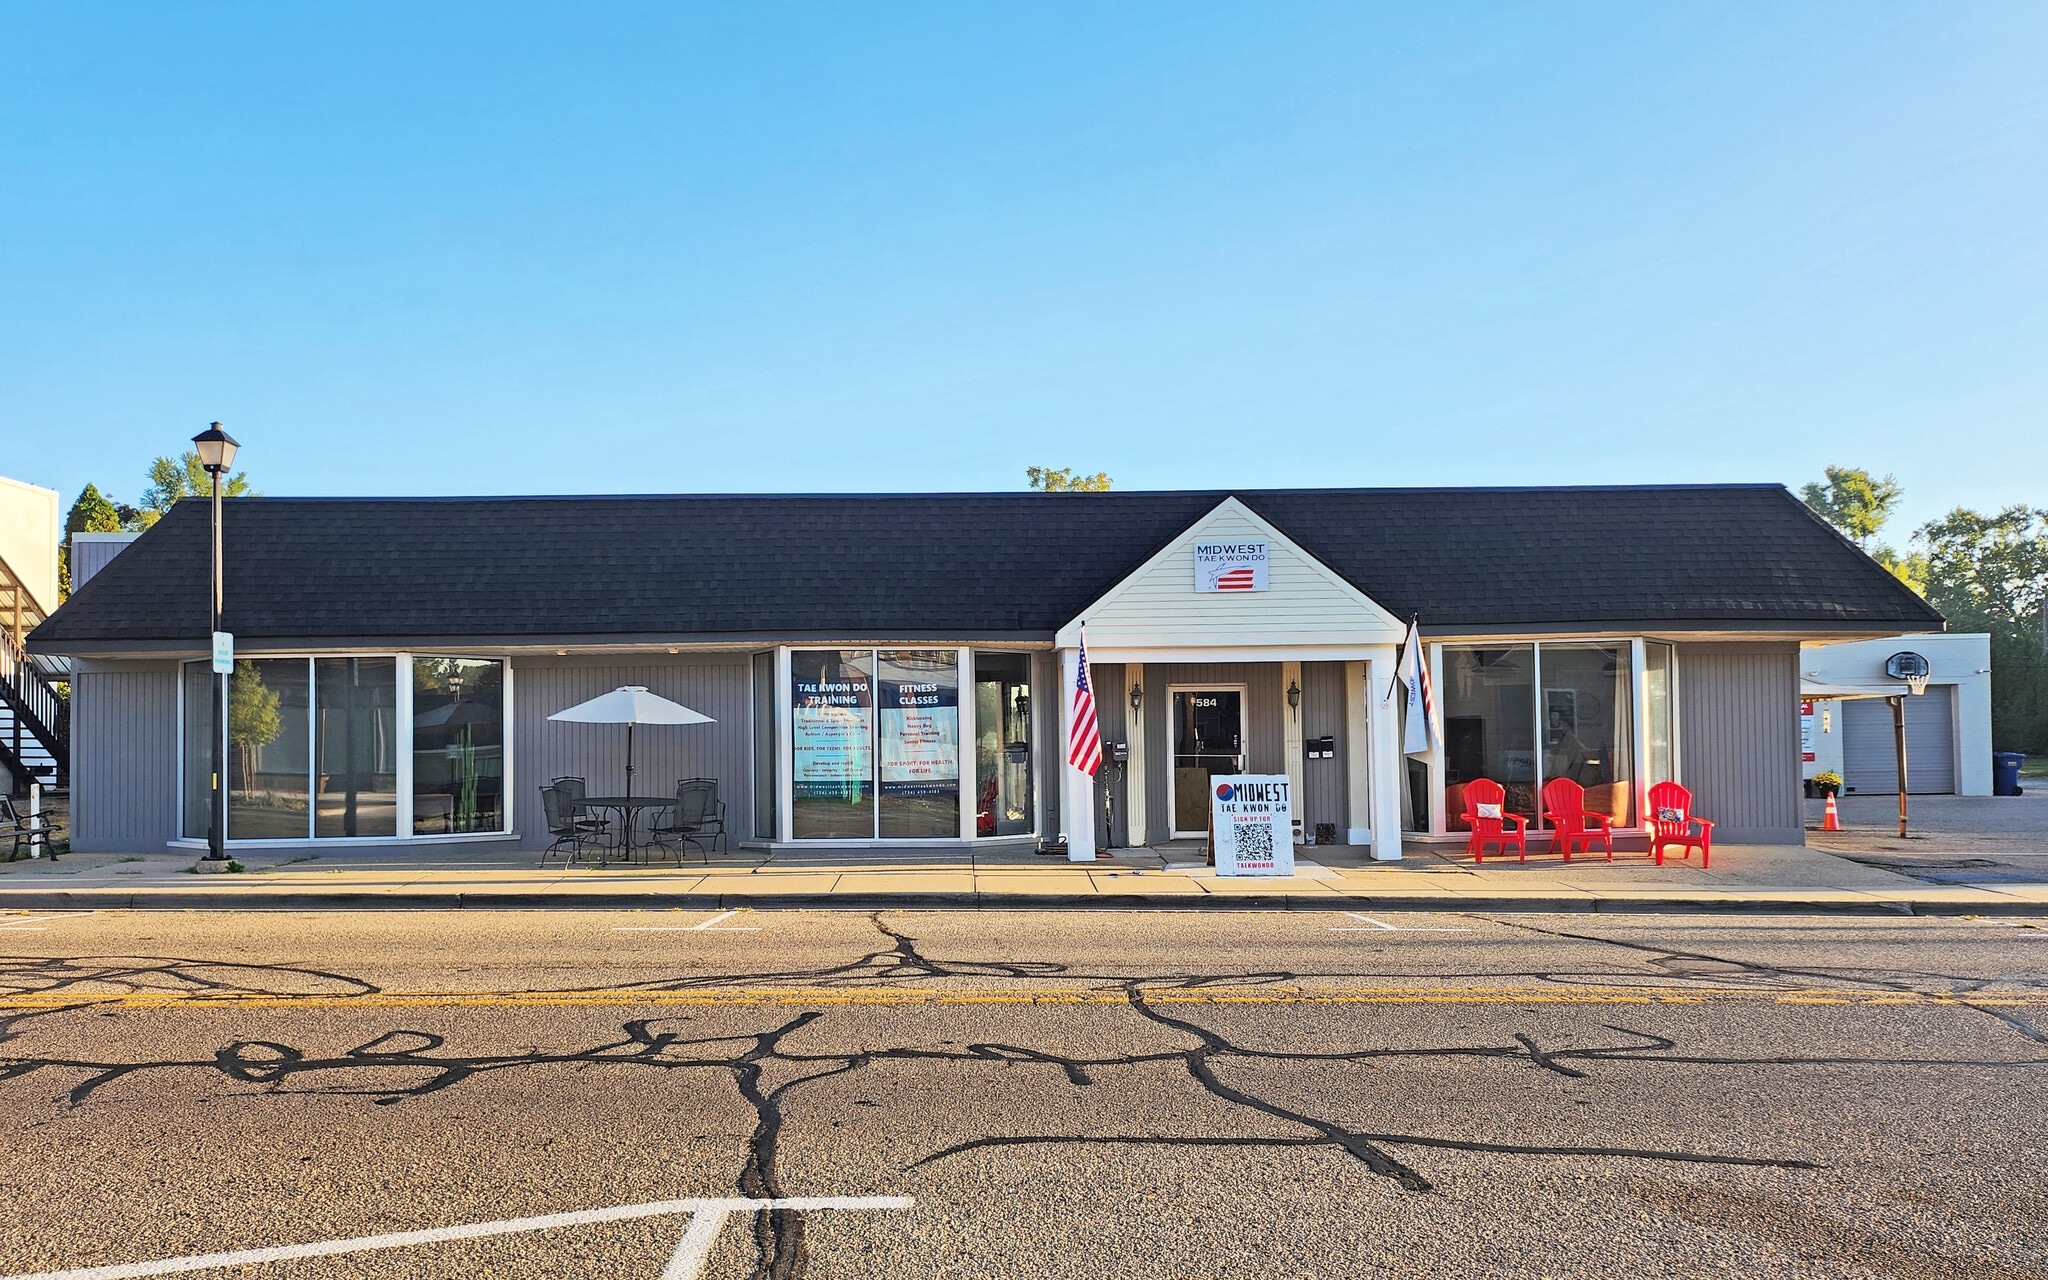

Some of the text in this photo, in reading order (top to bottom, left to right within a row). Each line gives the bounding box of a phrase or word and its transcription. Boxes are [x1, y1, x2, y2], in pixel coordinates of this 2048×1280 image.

[1198, 544, 1265, 554] MIDWEST
[798, 684, 867, 692] TAE KWON DO
[900, 684, 938, 692] FITNESS
[808, 696, 857, 704] TRAINING
[899, 696, 938, 704] CLASSES
[1196, 698, 1217, 707] 584
[1233, 783, 1288, 802] MIDWEST
[1221, 804, 1236, 812] TAE
[1244, 804, 1269, 812] KWON
